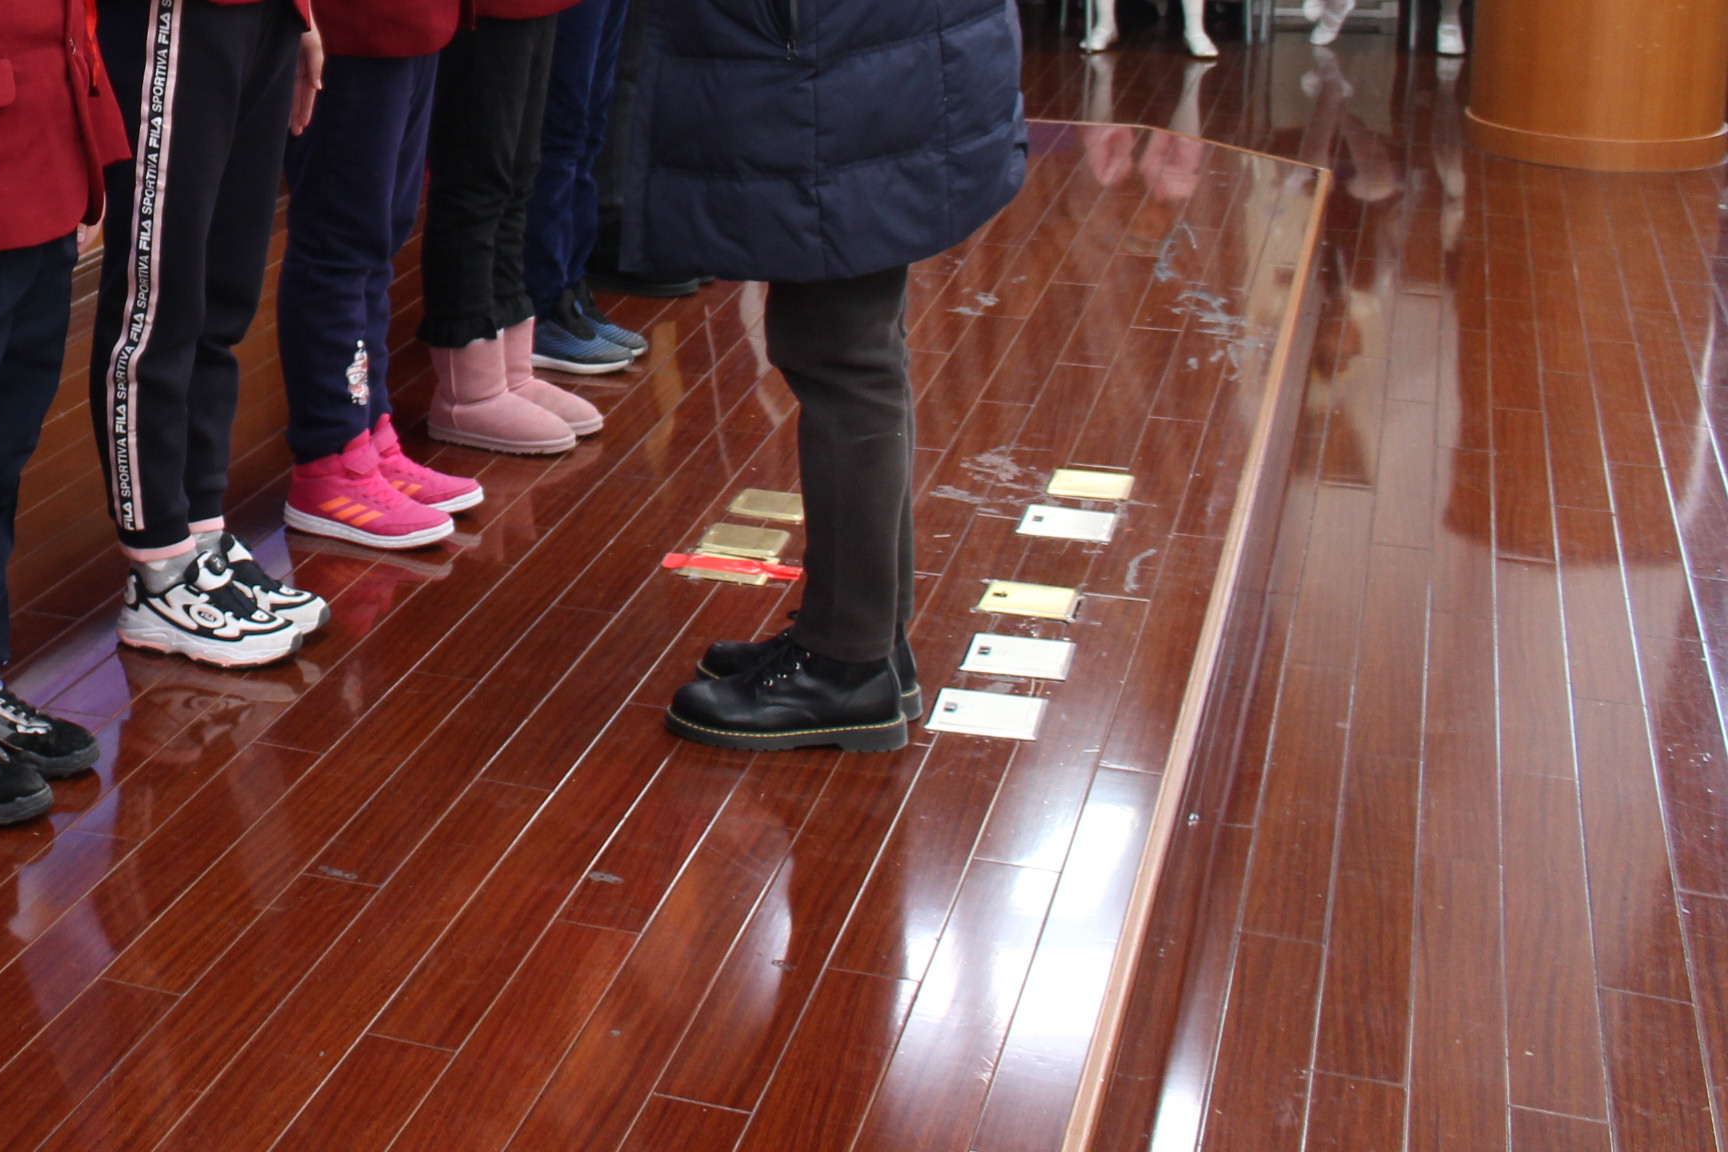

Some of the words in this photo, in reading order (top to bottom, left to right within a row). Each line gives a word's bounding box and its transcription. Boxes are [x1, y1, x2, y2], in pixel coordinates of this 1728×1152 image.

[157, 12, 171, 45] FILA
[151, 48, 168, 113] SPORTIVA
[148, 116, 163, 149] FILA
[141, 152, 159, 215] SPORTIVA
[138, 219, 152, 251] FILA
[130, 312, 145, 343] FILA
[115, 404, 127, 434] FILA
[117, 437, 132, 498] SPORTIVA
[122, 501, 135, 531] FILA
